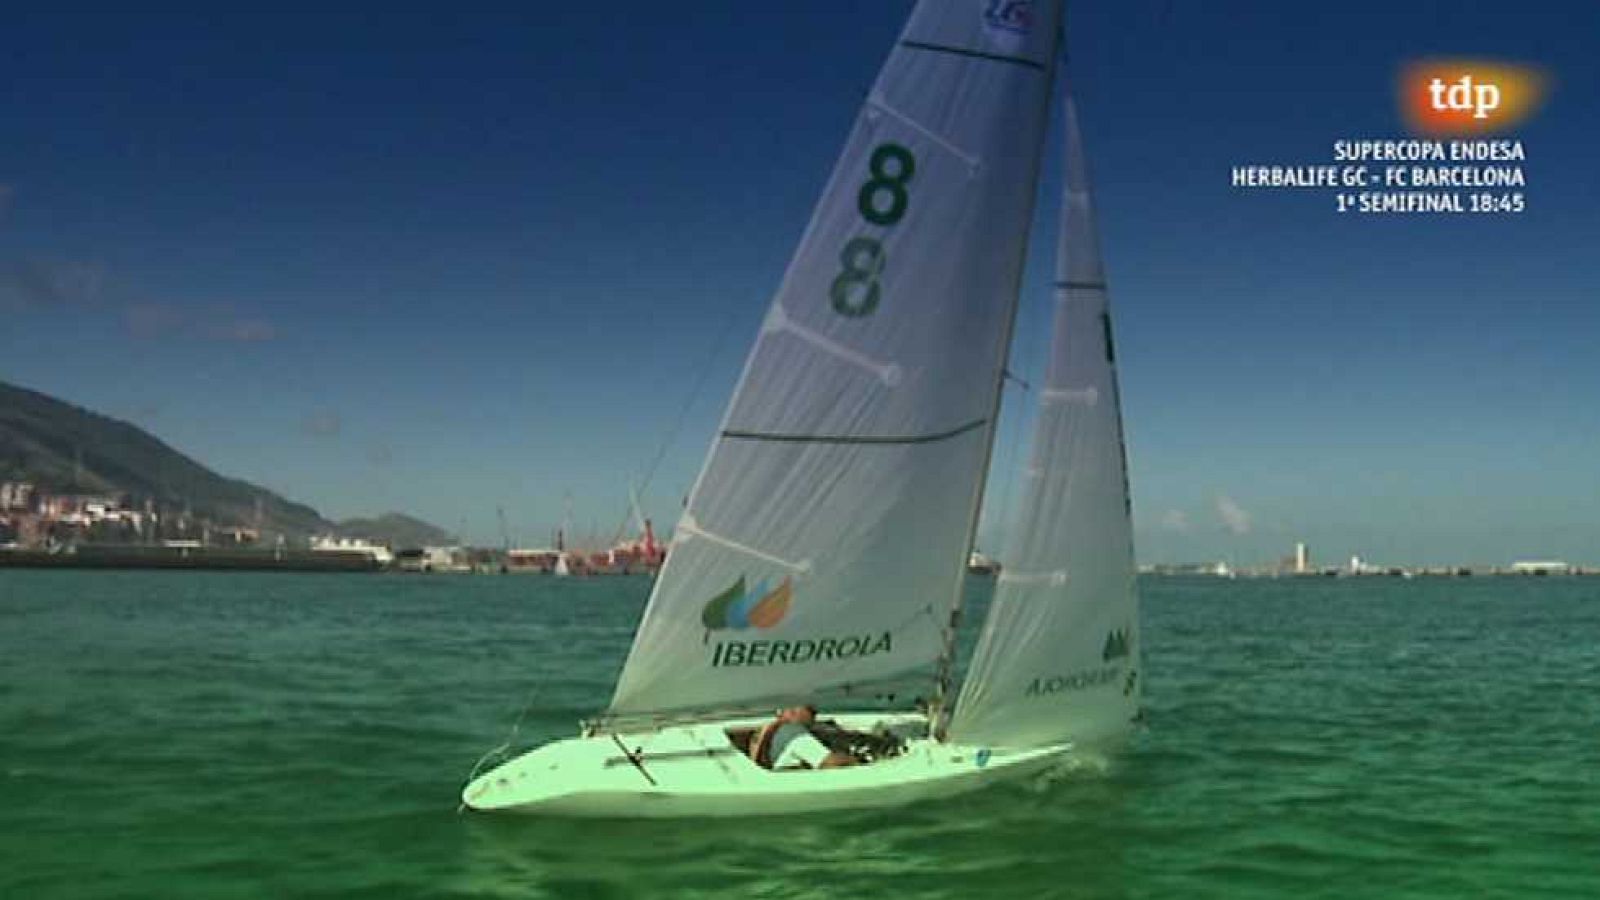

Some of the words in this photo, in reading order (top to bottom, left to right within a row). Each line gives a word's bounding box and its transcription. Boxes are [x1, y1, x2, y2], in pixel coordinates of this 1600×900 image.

[858, 142, 915, 226] 8
[829, 237, 886, 318] 8
[712, 631, 892, 668] IBERDROLA
